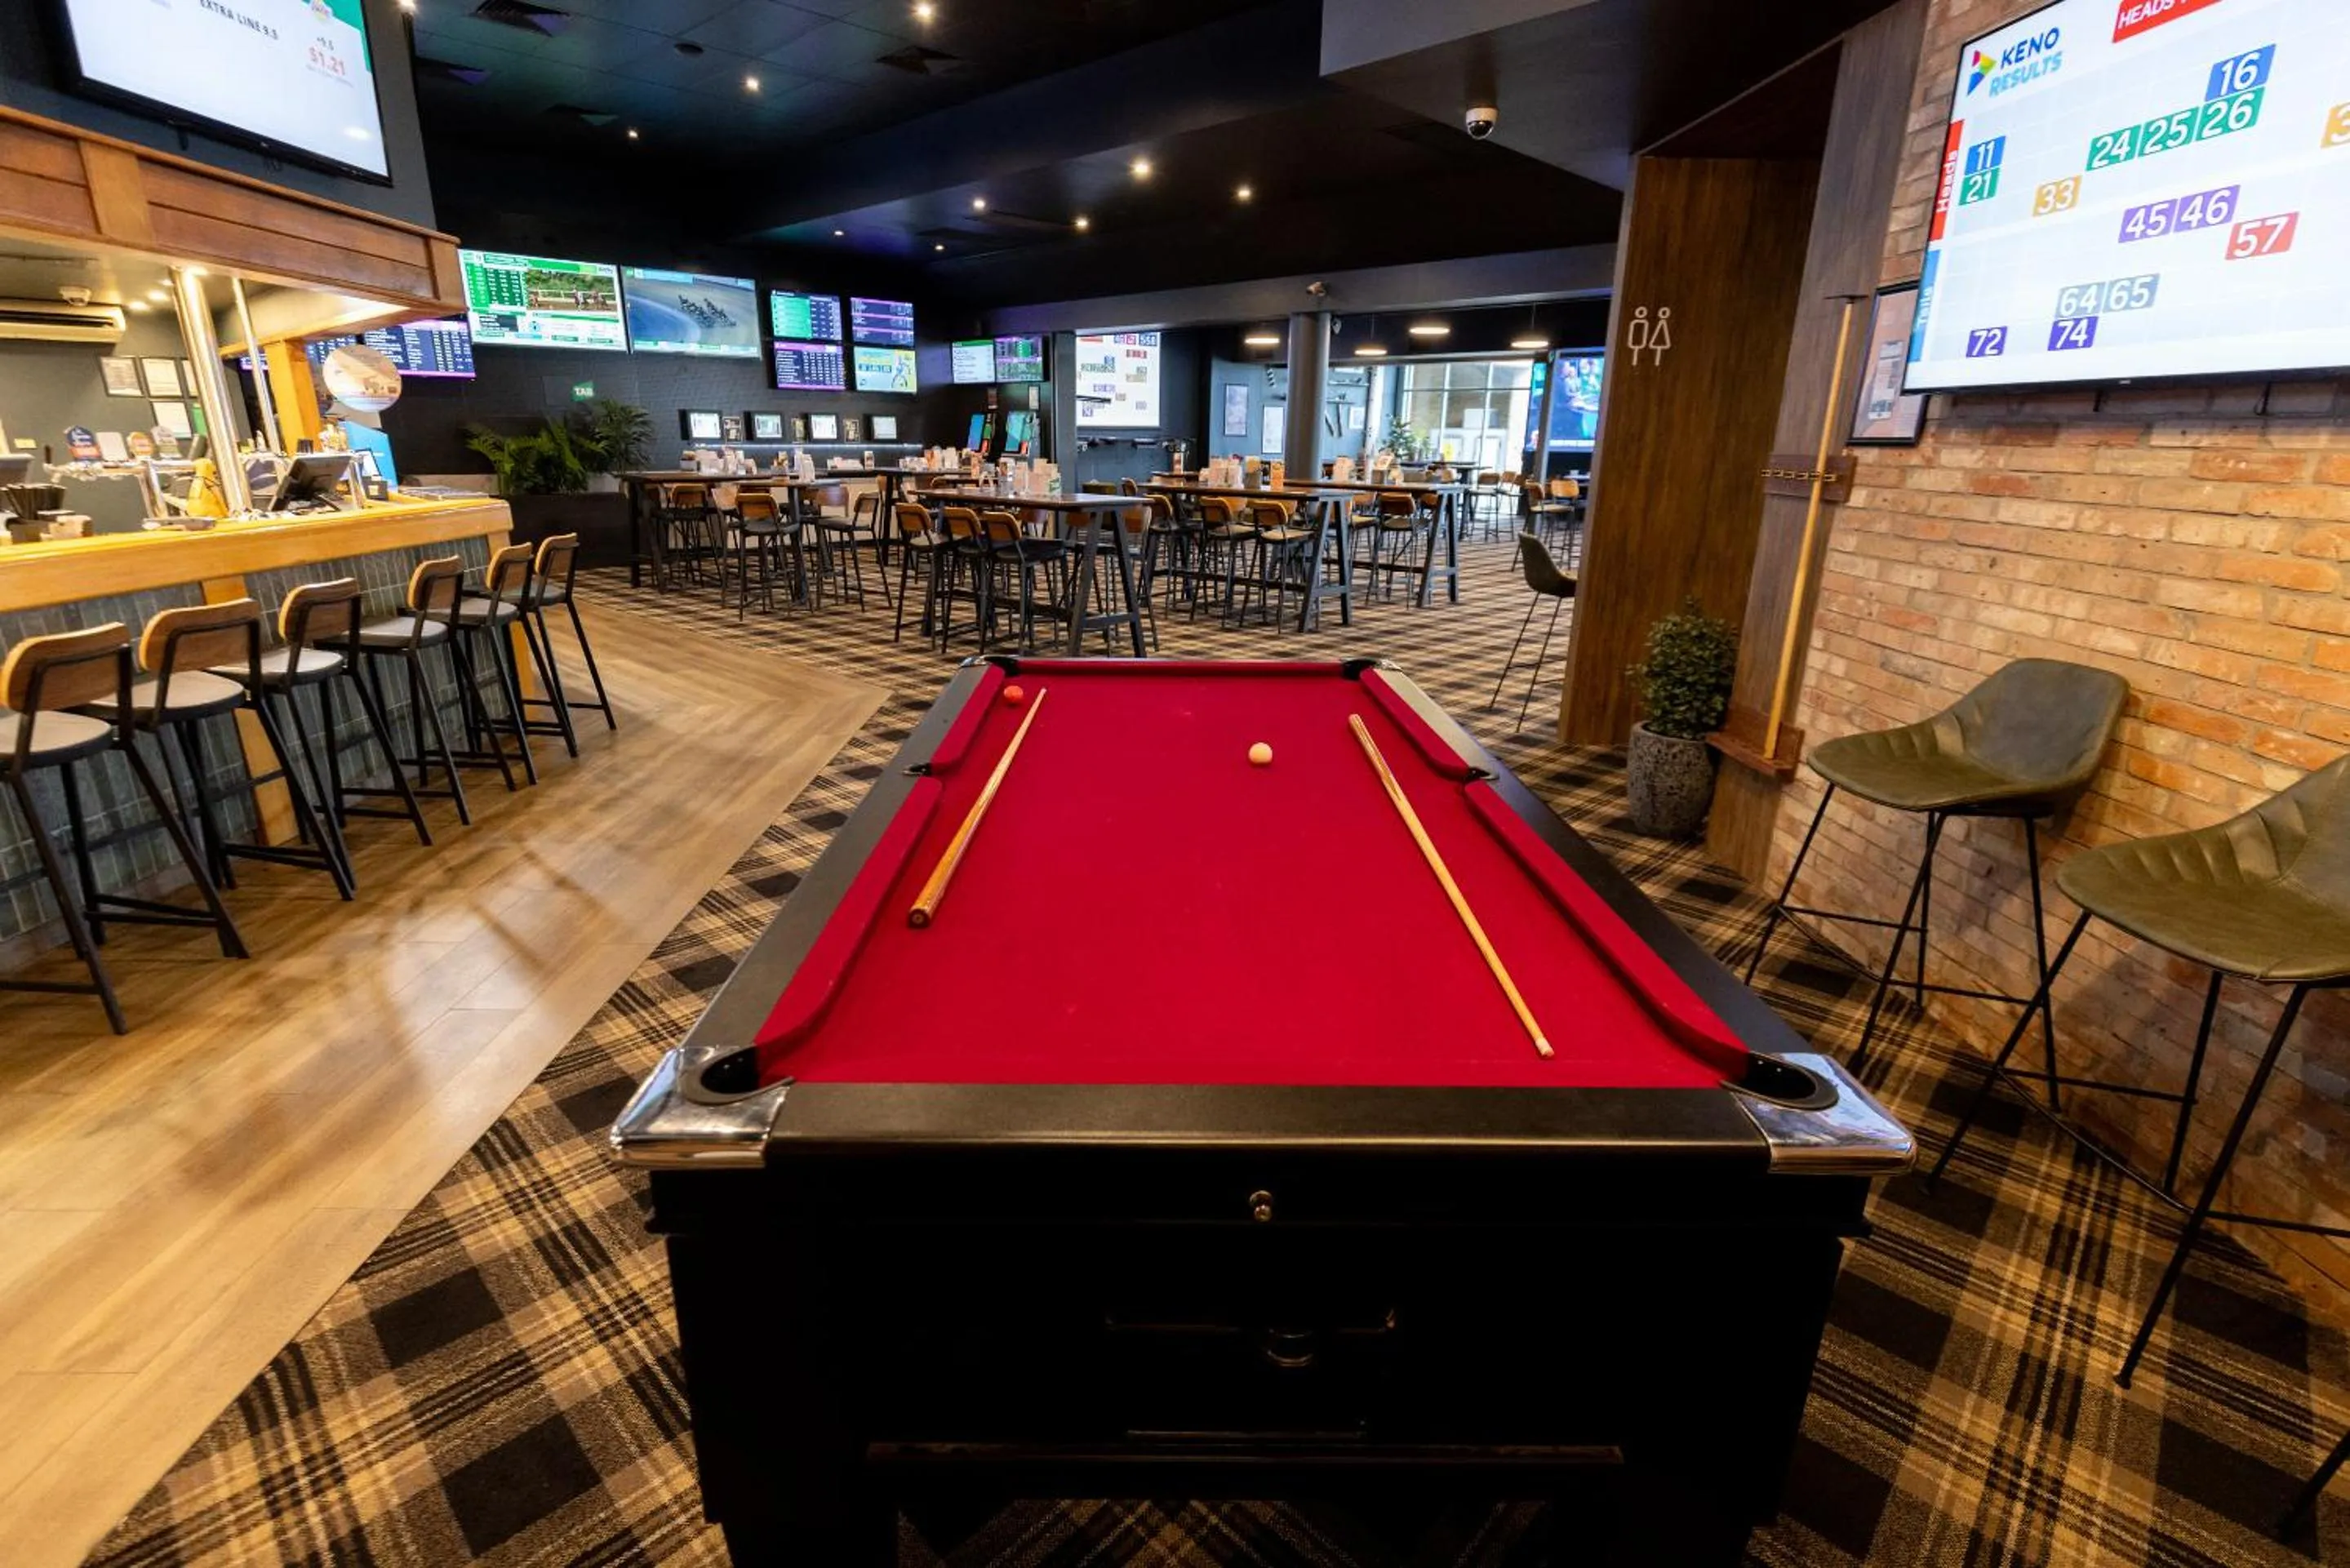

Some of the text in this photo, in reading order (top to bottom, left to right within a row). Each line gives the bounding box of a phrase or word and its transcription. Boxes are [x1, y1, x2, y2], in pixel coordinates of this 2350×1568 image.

[200, 0, 233, 20] EXTRA
[237, 13, 260, 32] LINE
[2001, 27, 2060, 69] KENO
[1988, 51, 2063, 97] RESULTS
[2220, 51, 2260, 96] 16
[2091, 92, 2254, 169] 24 25 26
[2330, 103, 2350, 143] 3
[1976, 140, 1996, 171] 11
[1935, 149, 1958, 214] Heads
[1966, 172, 1992, 203] 21
[2039, 180, 2075, 214] 33
[2126, 189, 2231, 239] 45 46
[2234, 215, 2289, 257] 57
[2059, 277, 2154, 318] 64 65
[1971, 328, 2002, 357] 72
[2055, 319, 2089, 350] 74
